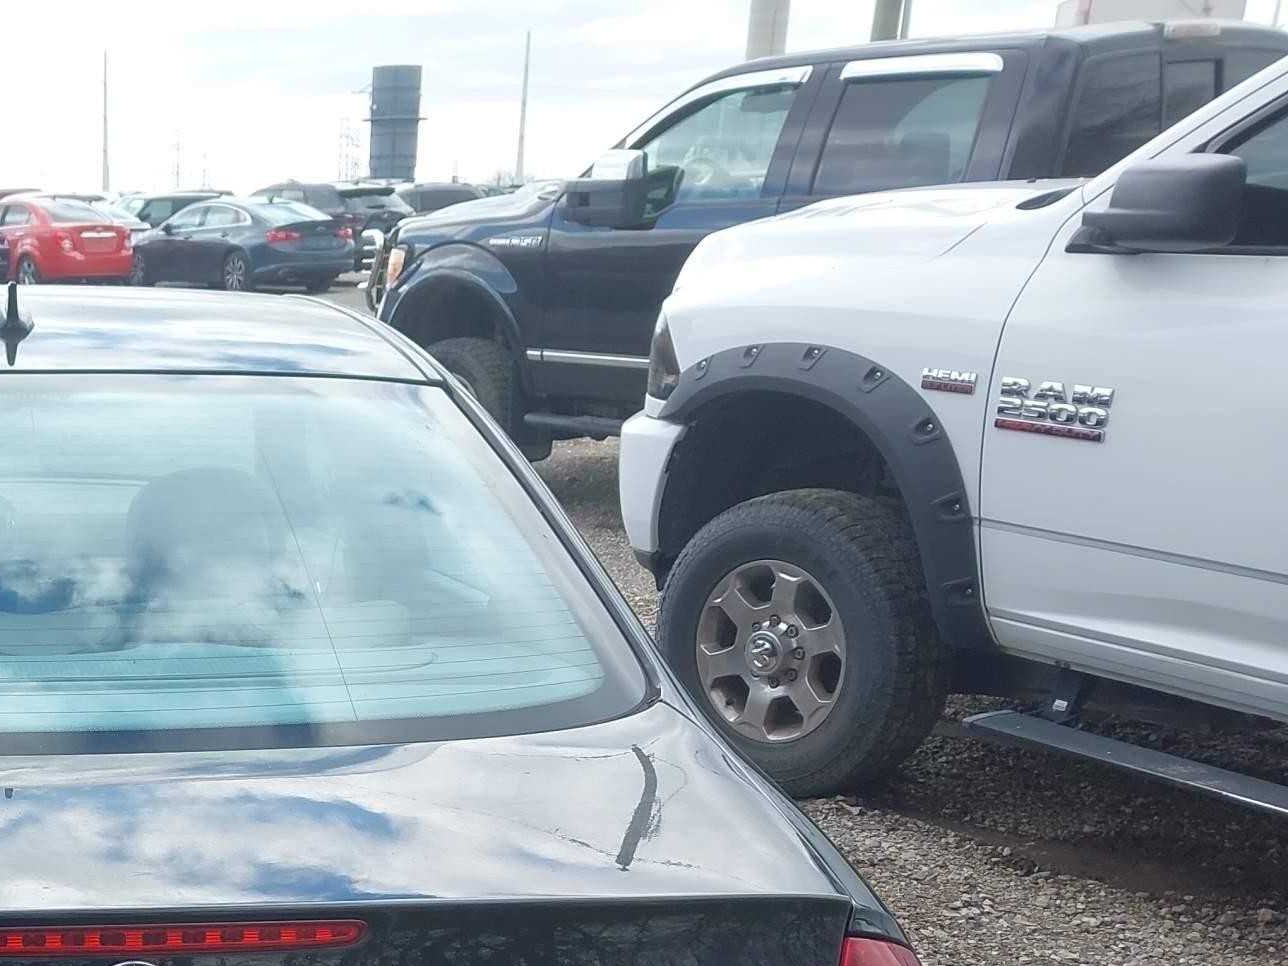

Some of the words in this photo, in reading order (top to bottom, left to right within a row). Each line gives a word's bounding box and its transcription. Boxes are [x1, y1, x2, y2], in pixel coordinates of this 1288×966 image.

[922, 367, 978, 383] HEMI
[1000, 376, 1115, 409] RAM
[997, 397, 1110, 428] 2500
